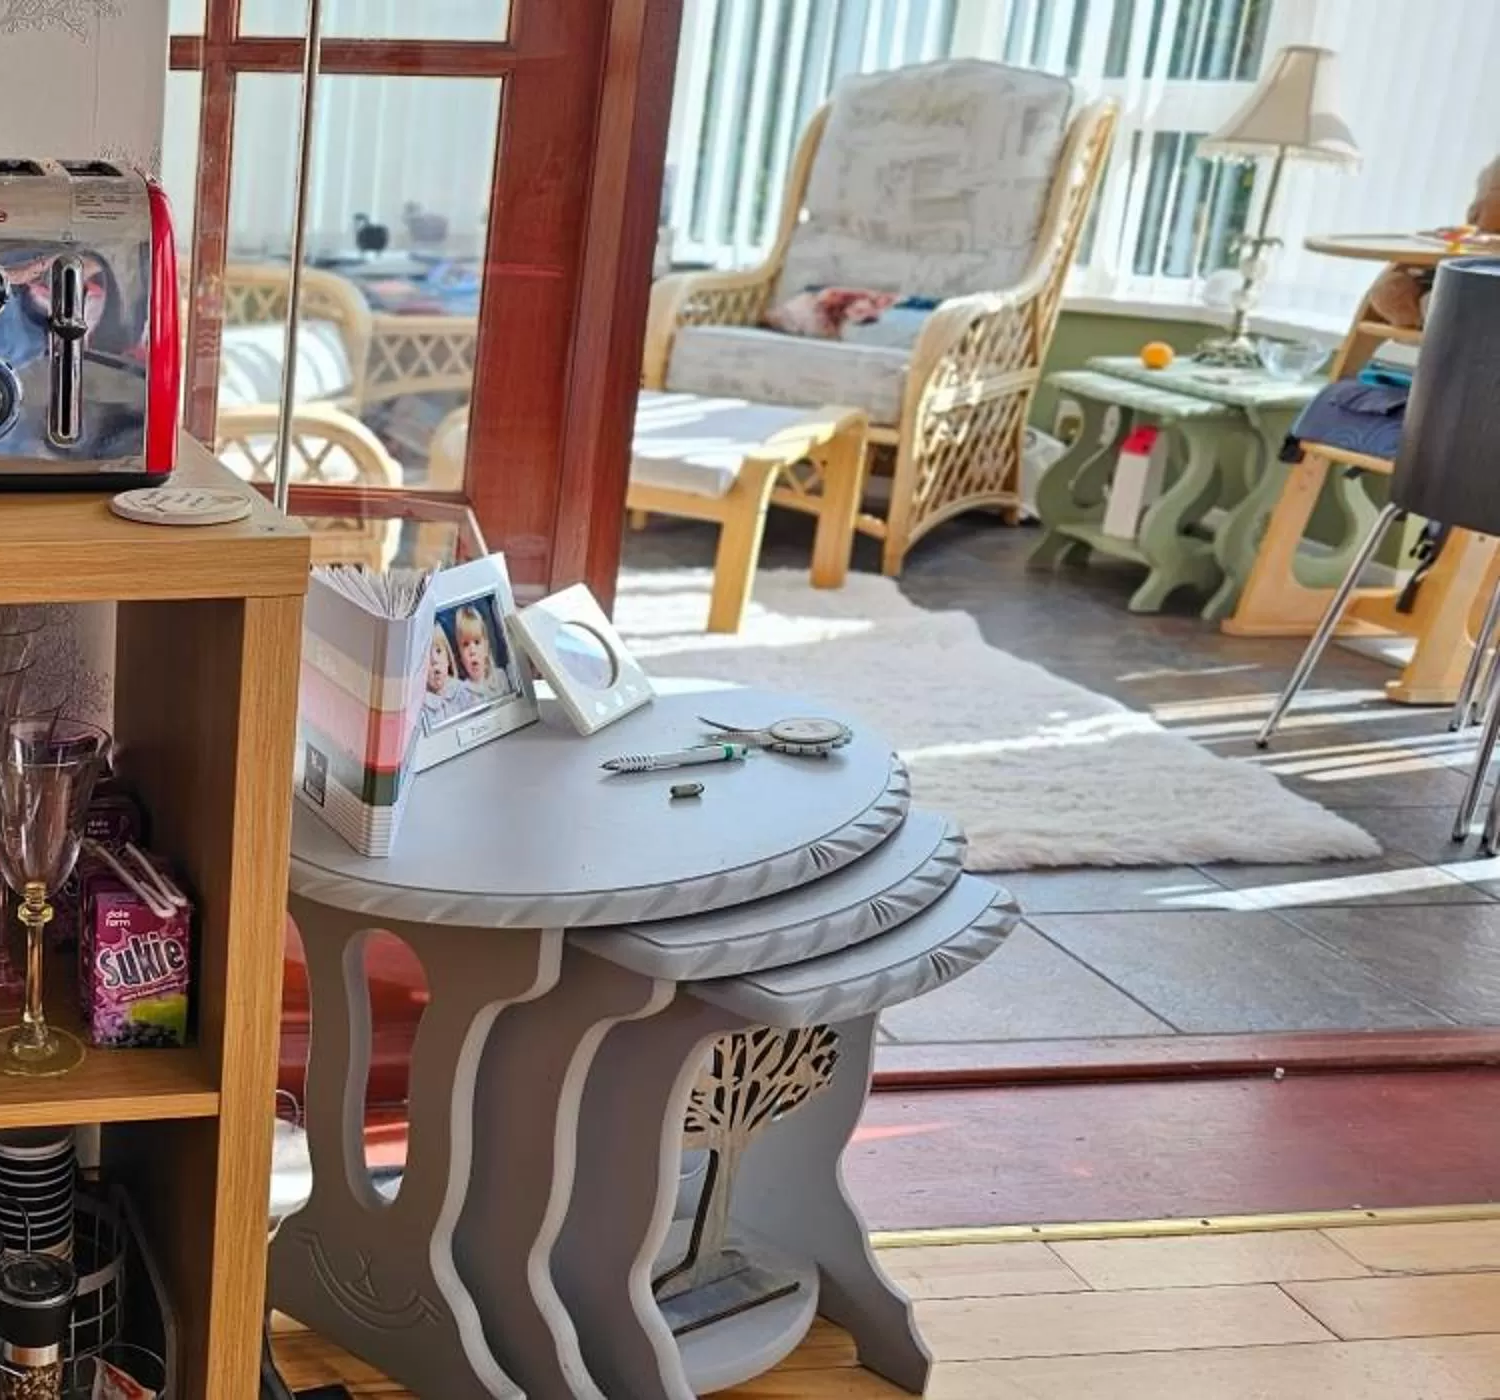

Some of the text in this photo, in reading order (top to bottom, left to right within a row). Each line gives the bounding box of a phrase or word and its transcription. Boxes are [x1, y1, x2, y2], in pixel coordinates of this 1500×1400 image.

[105, 909, 130, 919] dale
[105, 919, 131, 927] farm
[97, 932, 187, 989] Sukie
